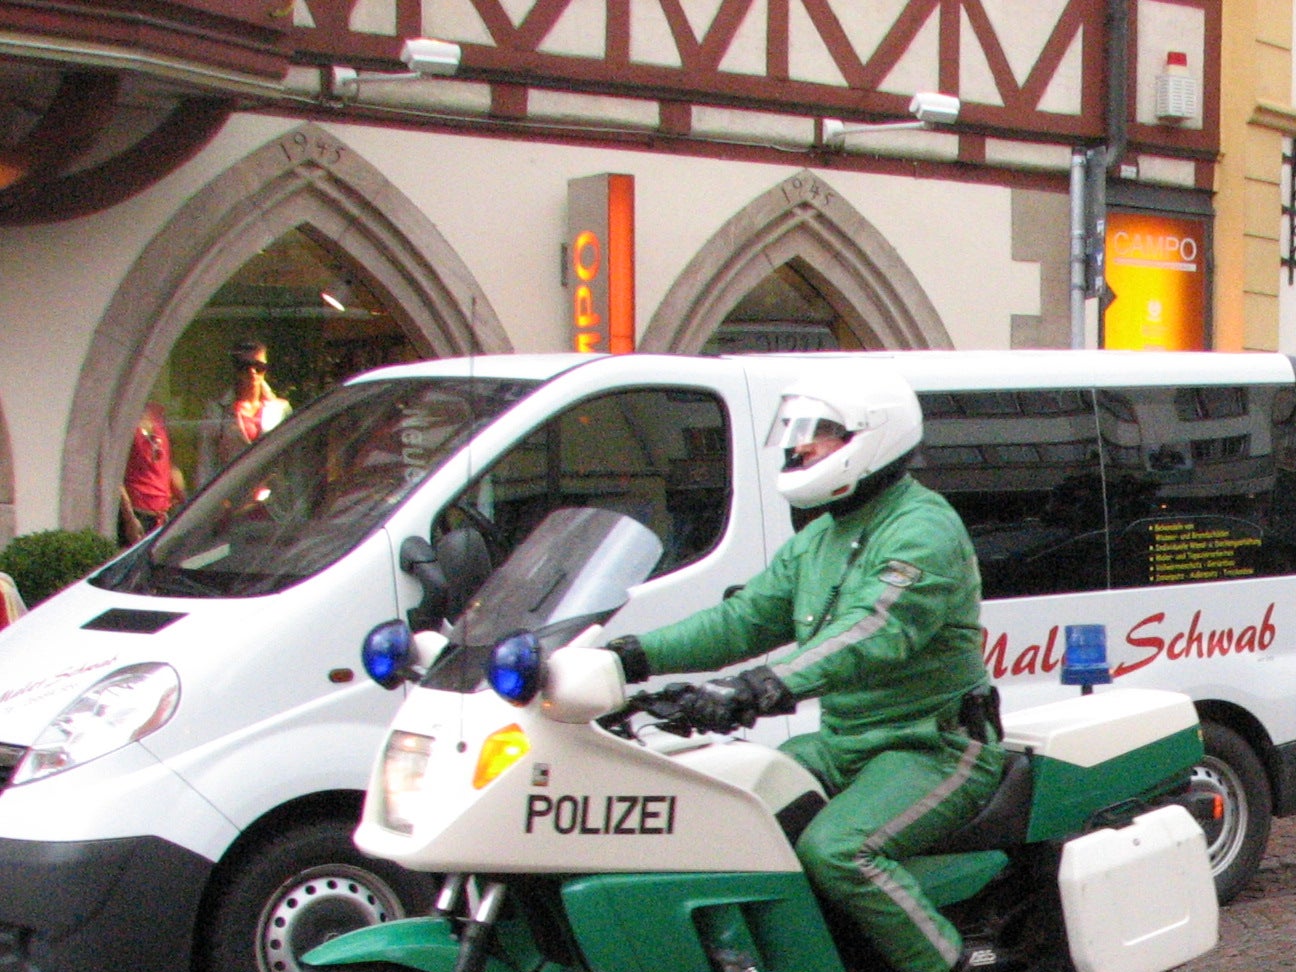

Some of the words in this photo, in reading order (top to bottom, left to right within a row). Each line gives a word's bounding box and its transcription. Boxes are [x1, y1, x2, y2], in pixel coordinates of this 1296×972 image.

[1113, 231, 1197, 261] CAMPO
[1114, 602, 1276, 678] Schwab
[525, 794, 677, 835] POLIZEI
